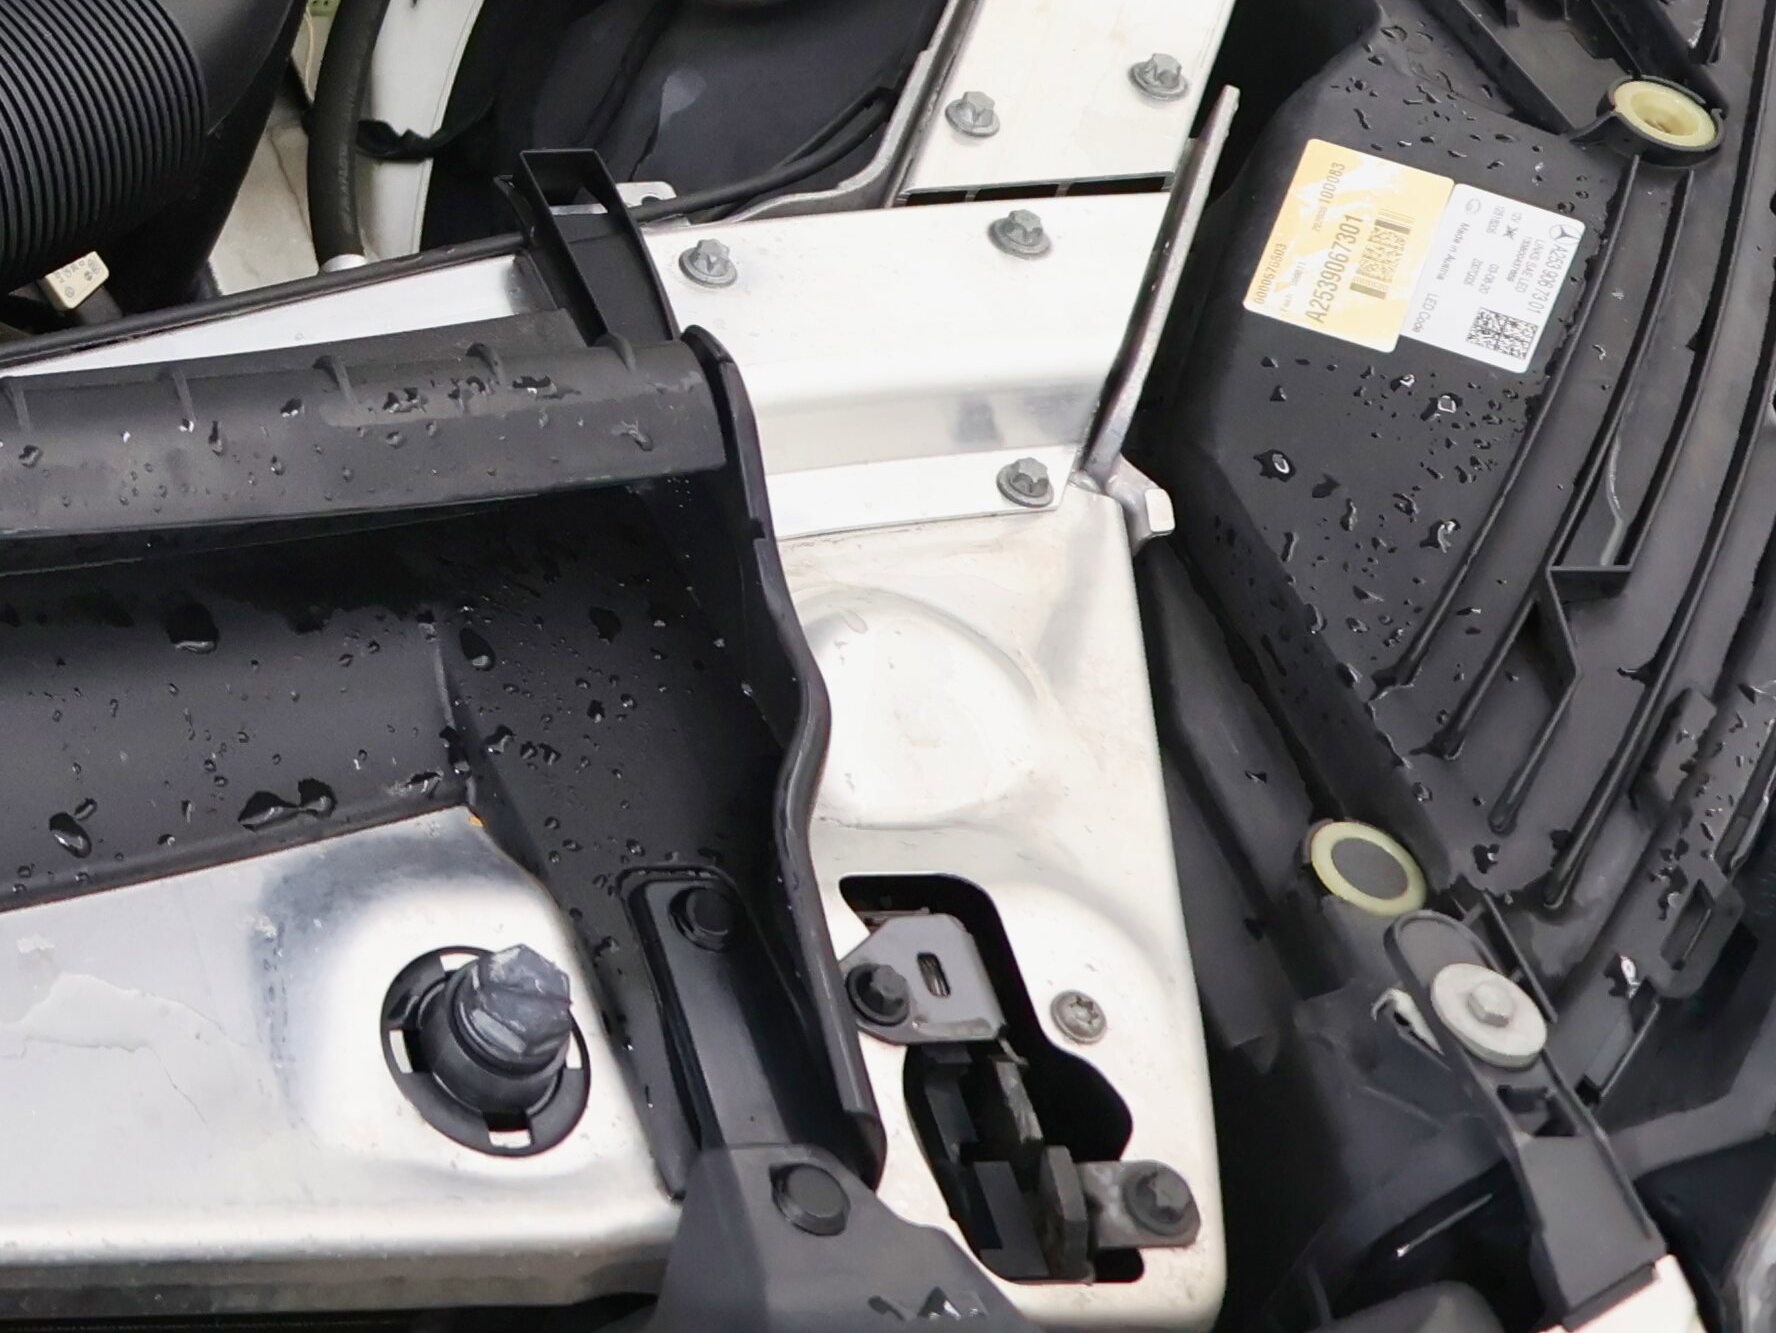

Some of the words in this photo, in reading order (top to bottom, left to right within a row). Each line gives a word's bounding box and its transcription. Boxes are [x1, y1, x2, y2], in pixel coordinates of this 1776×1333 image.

[1454, 222, 1469, 244] Made
[1436, 253, 1455, 281] Austria
[1544, 244, 1567, 270] A253
[1304, 213, 1363, 323] A2539067301
[1514, 277, 1528, 293] LED
[1536, 269, 1557, 288] 906
[1421, 292, 1437, 310] LED
[1531, 288, 1550, 302] 73
[1526, 301, 1544, 314] 01
[1411, 310, 1431, 333] Code
